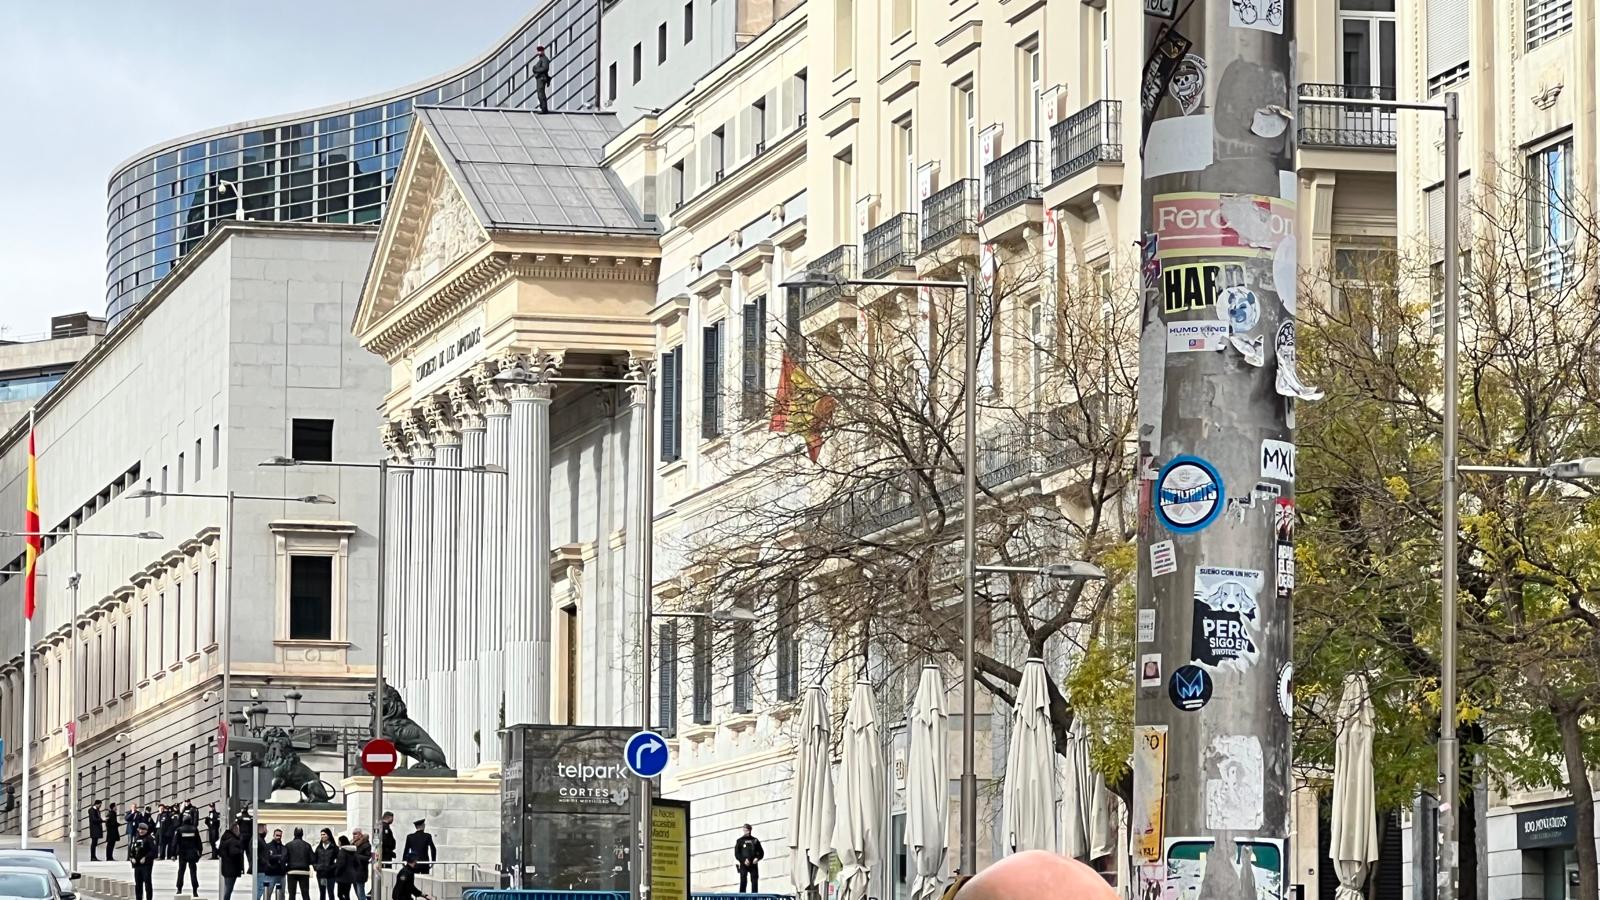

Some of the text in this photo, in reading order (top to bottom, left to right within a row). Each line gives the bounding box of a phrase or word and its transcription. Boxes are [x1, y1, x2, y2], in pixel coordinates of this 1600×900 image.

[1200, 325, 1227, 333] KING
[446, 344, 455, 364] LOS
[1210, 637, 1249, 650] SIGO EN
[557, 762, 629, 782] telpark
[559, 787, 609, 797] CORTES
